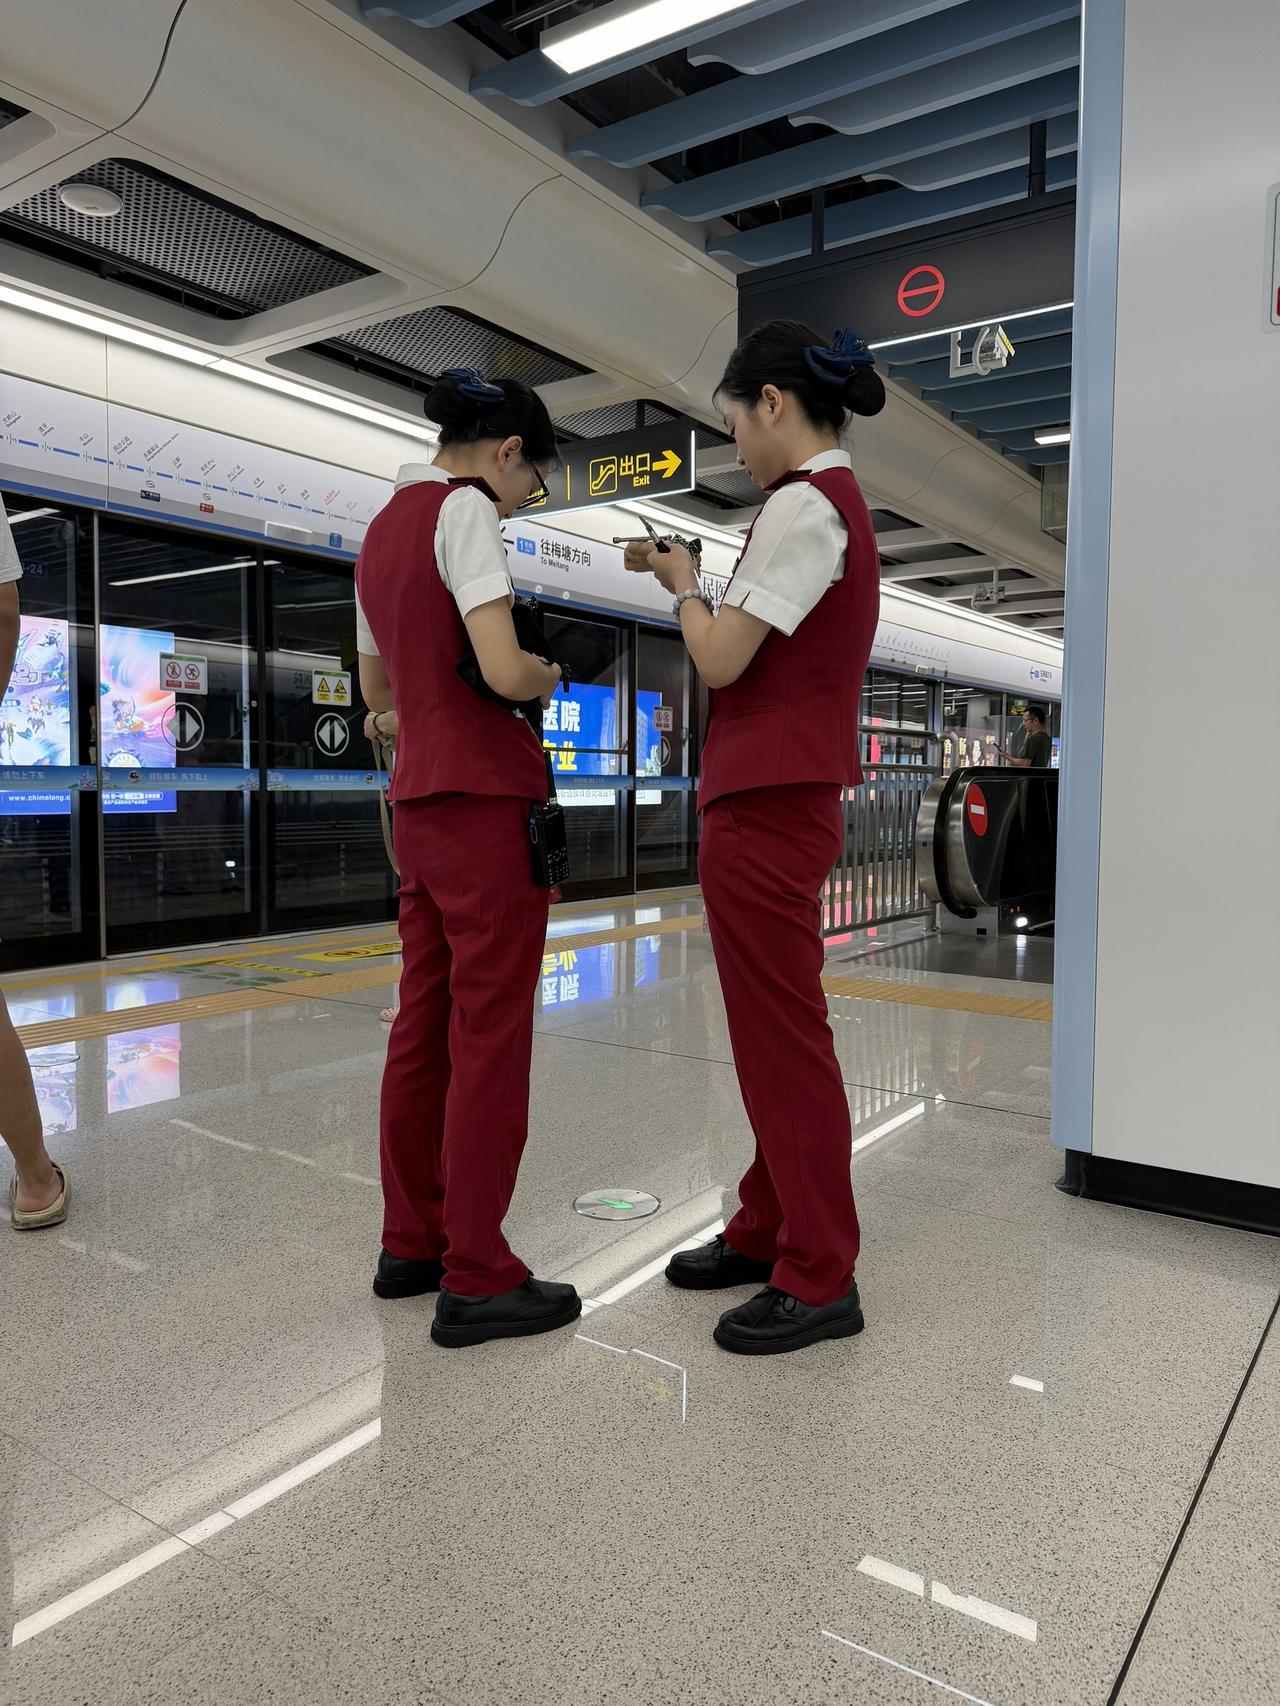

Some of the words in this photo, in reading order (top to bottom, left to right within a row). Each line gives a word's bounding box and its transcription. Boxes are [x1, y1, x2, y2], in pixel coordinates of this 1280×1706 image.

[620, 453, 650, 476] 出口
[633, 476, 651, 487] Exit
[540, 538, 591, 567] 往梅塘方向
[541, 556, 548, 565] To
[548, 558, 570, 572] Meitang
[543, 700, 581, 732] 医院
